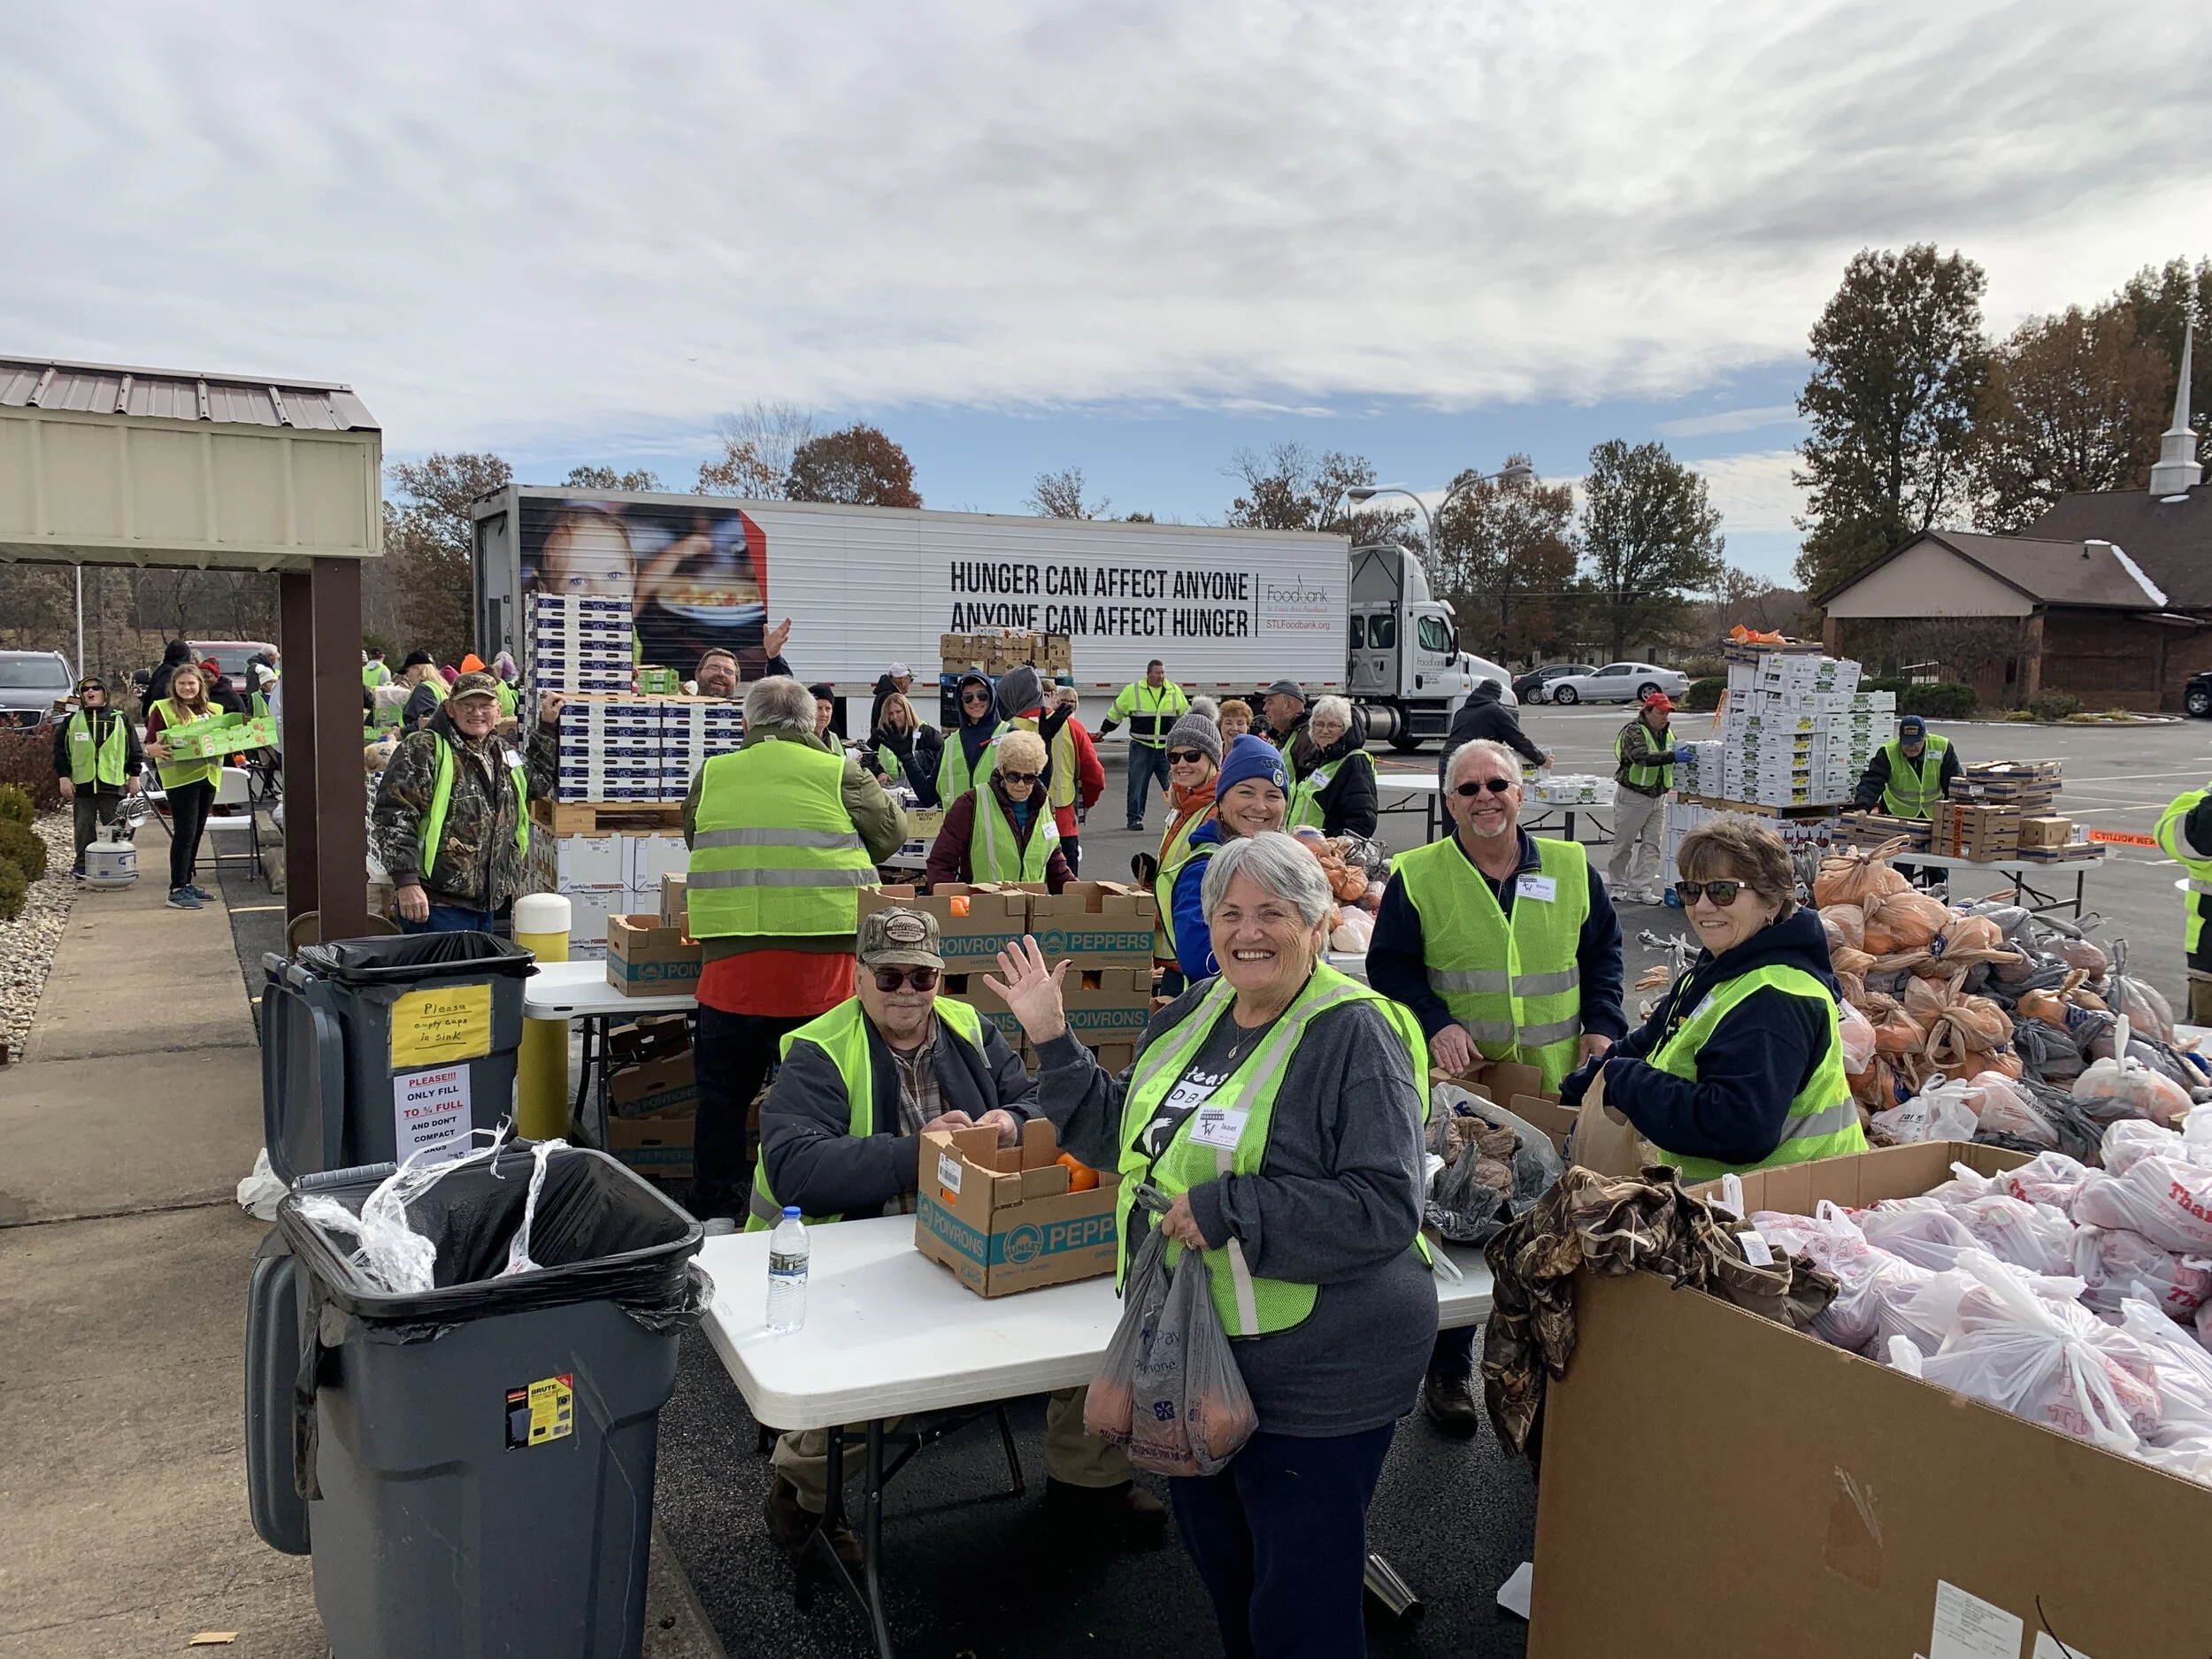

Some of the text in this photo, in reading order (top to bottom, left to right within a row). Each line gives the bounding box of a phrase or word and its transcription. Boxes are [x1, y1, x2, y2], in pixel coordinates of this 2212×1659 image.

[951, 561, 1248, 600] HUNGER CAN AFFECT ANYONE
[950, 603, 1248, 637] ANYONE CAN AFFECT HUNGER
[1266, 619, 1331, 631] STLFoodbank.org
[1071, 933, 1149, 949] PEPPERS
[424, 1002, 466, 1015] Please
[414, 1018, 467, 1031] empty cups
[1065, 1010, 1145, 1027] POIVRONS
[420, 1033, 429, 1041] in
[409, 1071, 457, 1087] PLEASE!!!
[407, 1086, 459, 1102] ONLY FILL
[403, 1108, 419, 1118] TO
[436, 1100, 464, 1112] FULL
[411, 1122, 430, 1132] AND
[414, 1129, 456, 1143] COMPACT
[933, 1210, 985, 1258] POIVRONS
[1004, 1241, 1042, 1259] SUNSET
[532, 1384, 557, 1396] BRUTE
